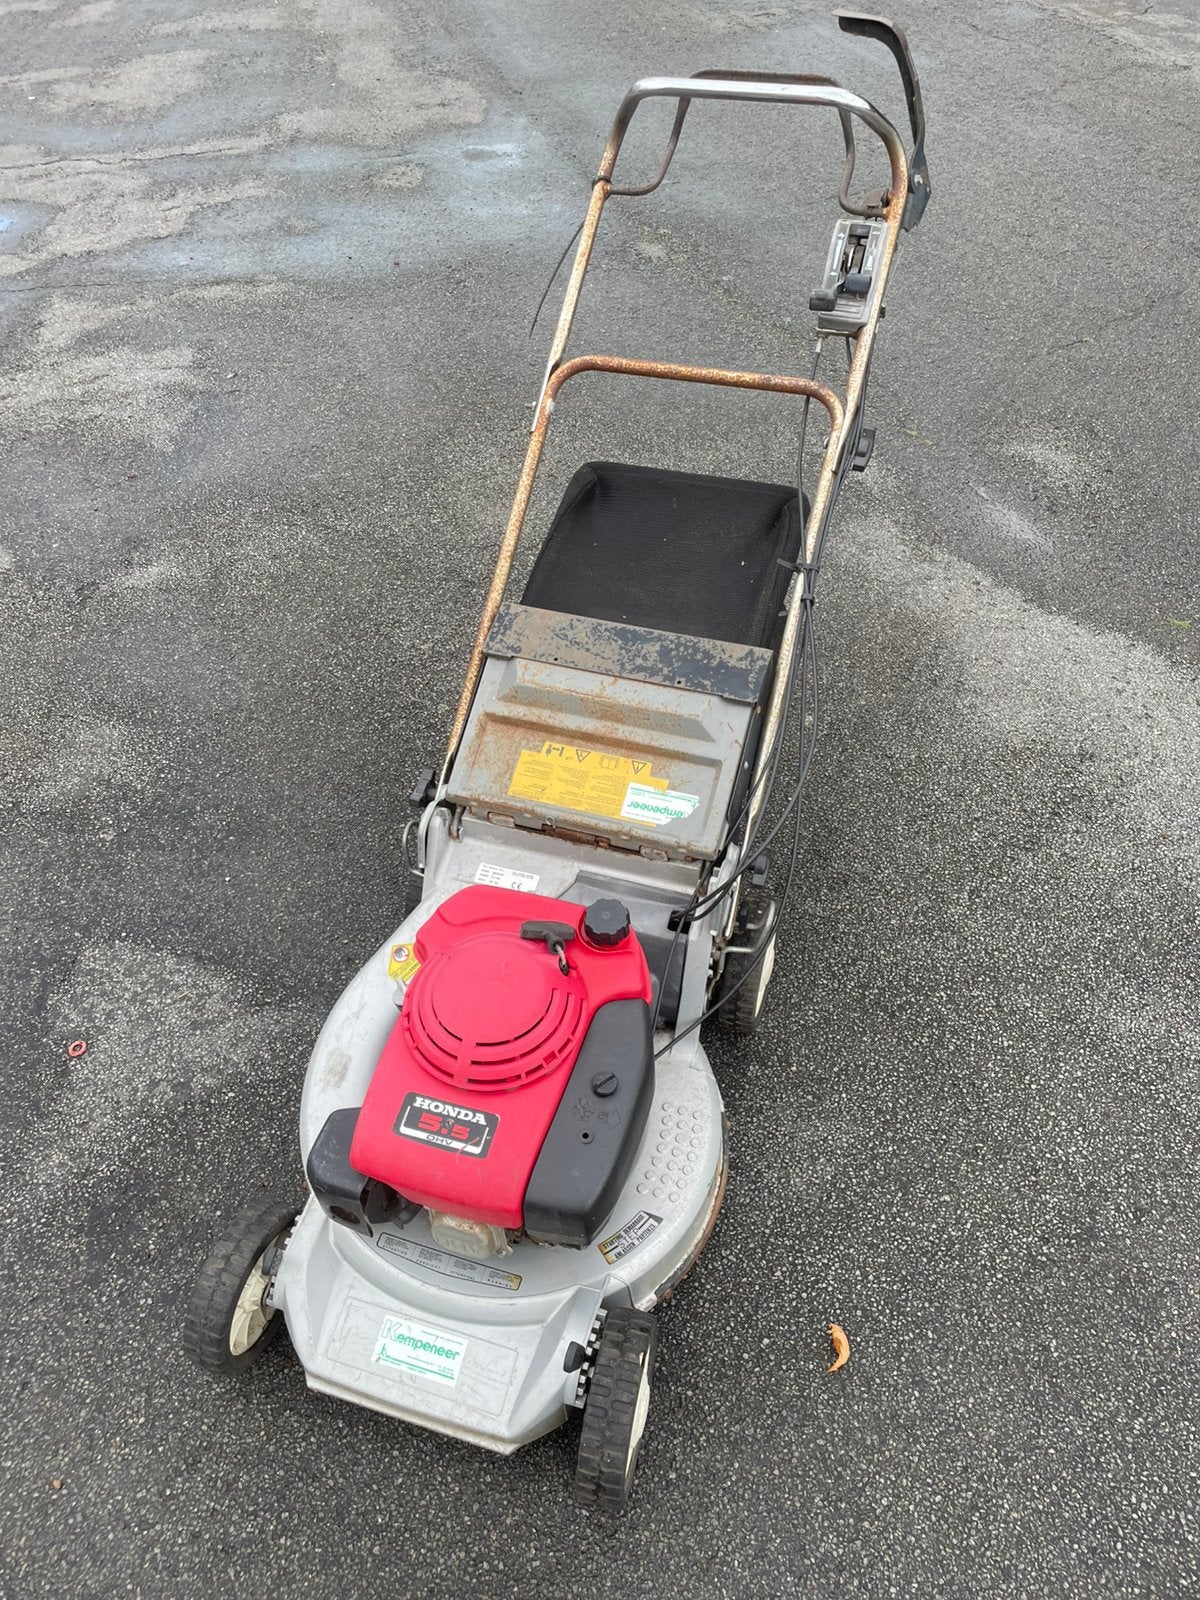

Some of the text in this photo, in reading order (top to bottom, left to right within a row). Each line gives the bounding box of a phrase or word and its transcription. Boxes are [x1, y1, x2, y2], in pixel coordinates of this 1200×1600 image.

[627, 801, 688, 819] empeneer
[413, 1096, 487, 1126] HONDA
[418, 1112, 471, 1140] 5.5
[426, 1134, 453, 1146] OHV
[618, 1228, 641, 1249] STEP
[381, 1319, 460, 1361] Kempeneer
